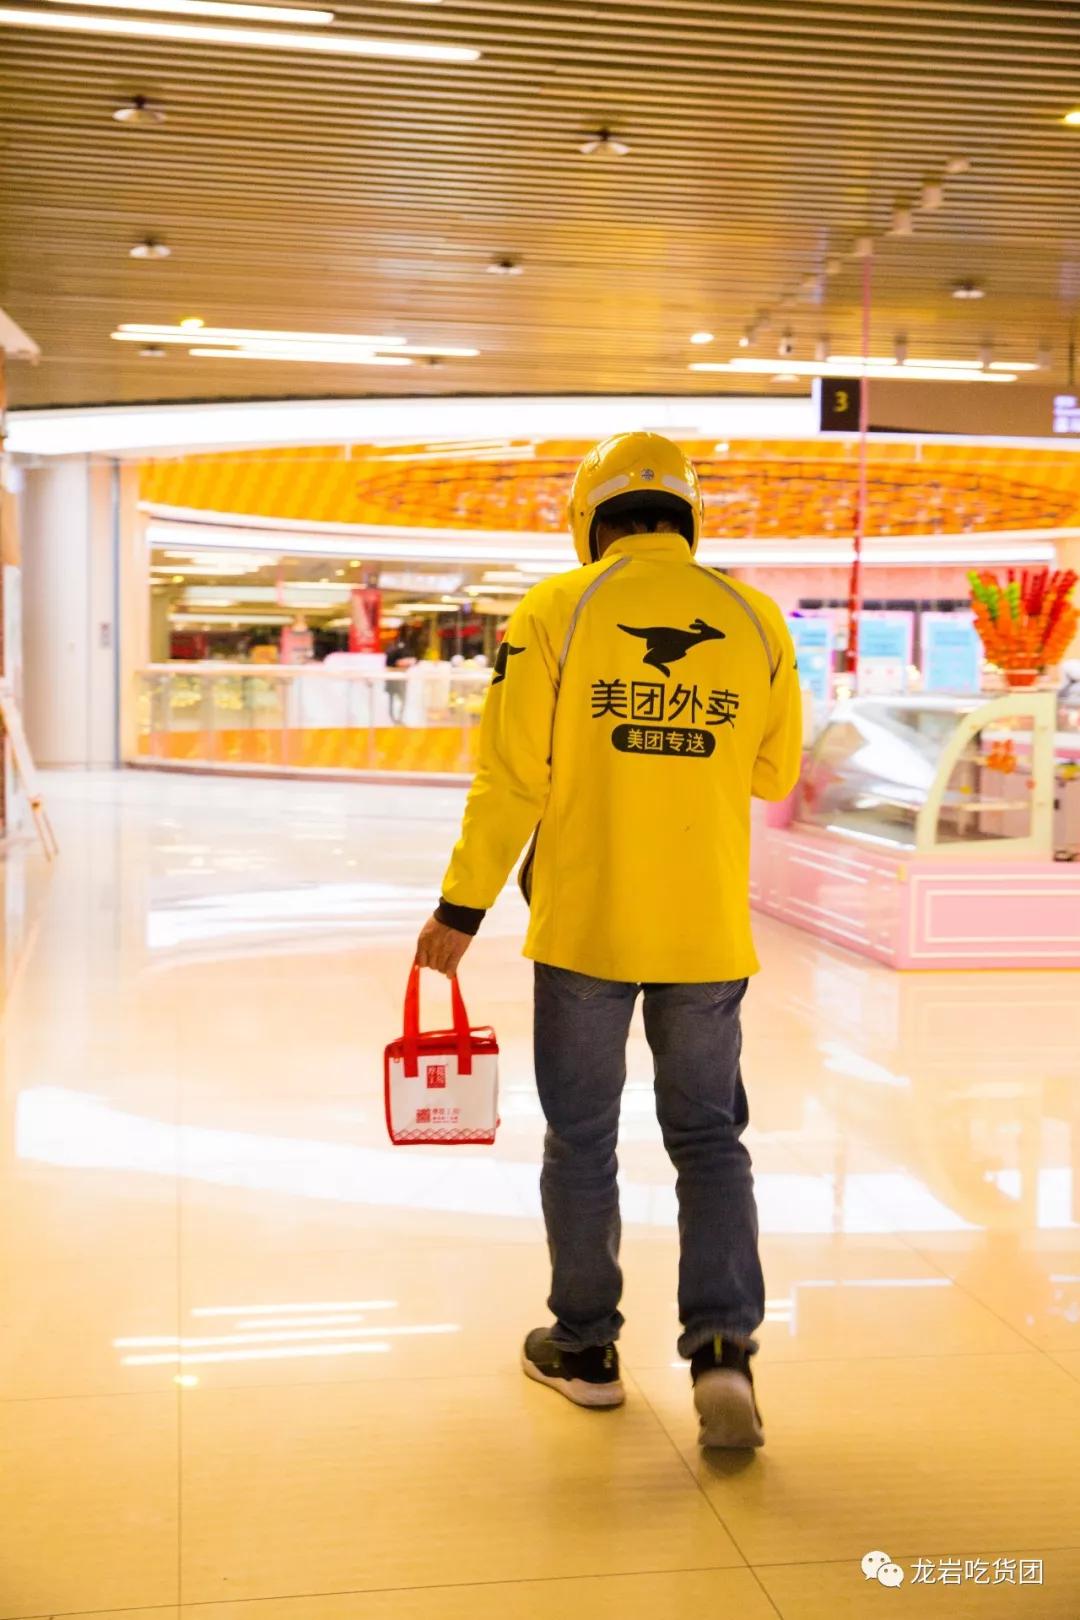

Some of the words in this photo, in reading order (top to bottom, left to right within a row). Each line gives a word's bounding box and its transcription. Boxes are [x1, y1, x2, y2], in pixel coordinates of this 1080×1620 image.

[833, 390, 849, 413] 3
[591, 678, 740, 729] 美团外卖
[626, 729, 706, 754] 美团专送
